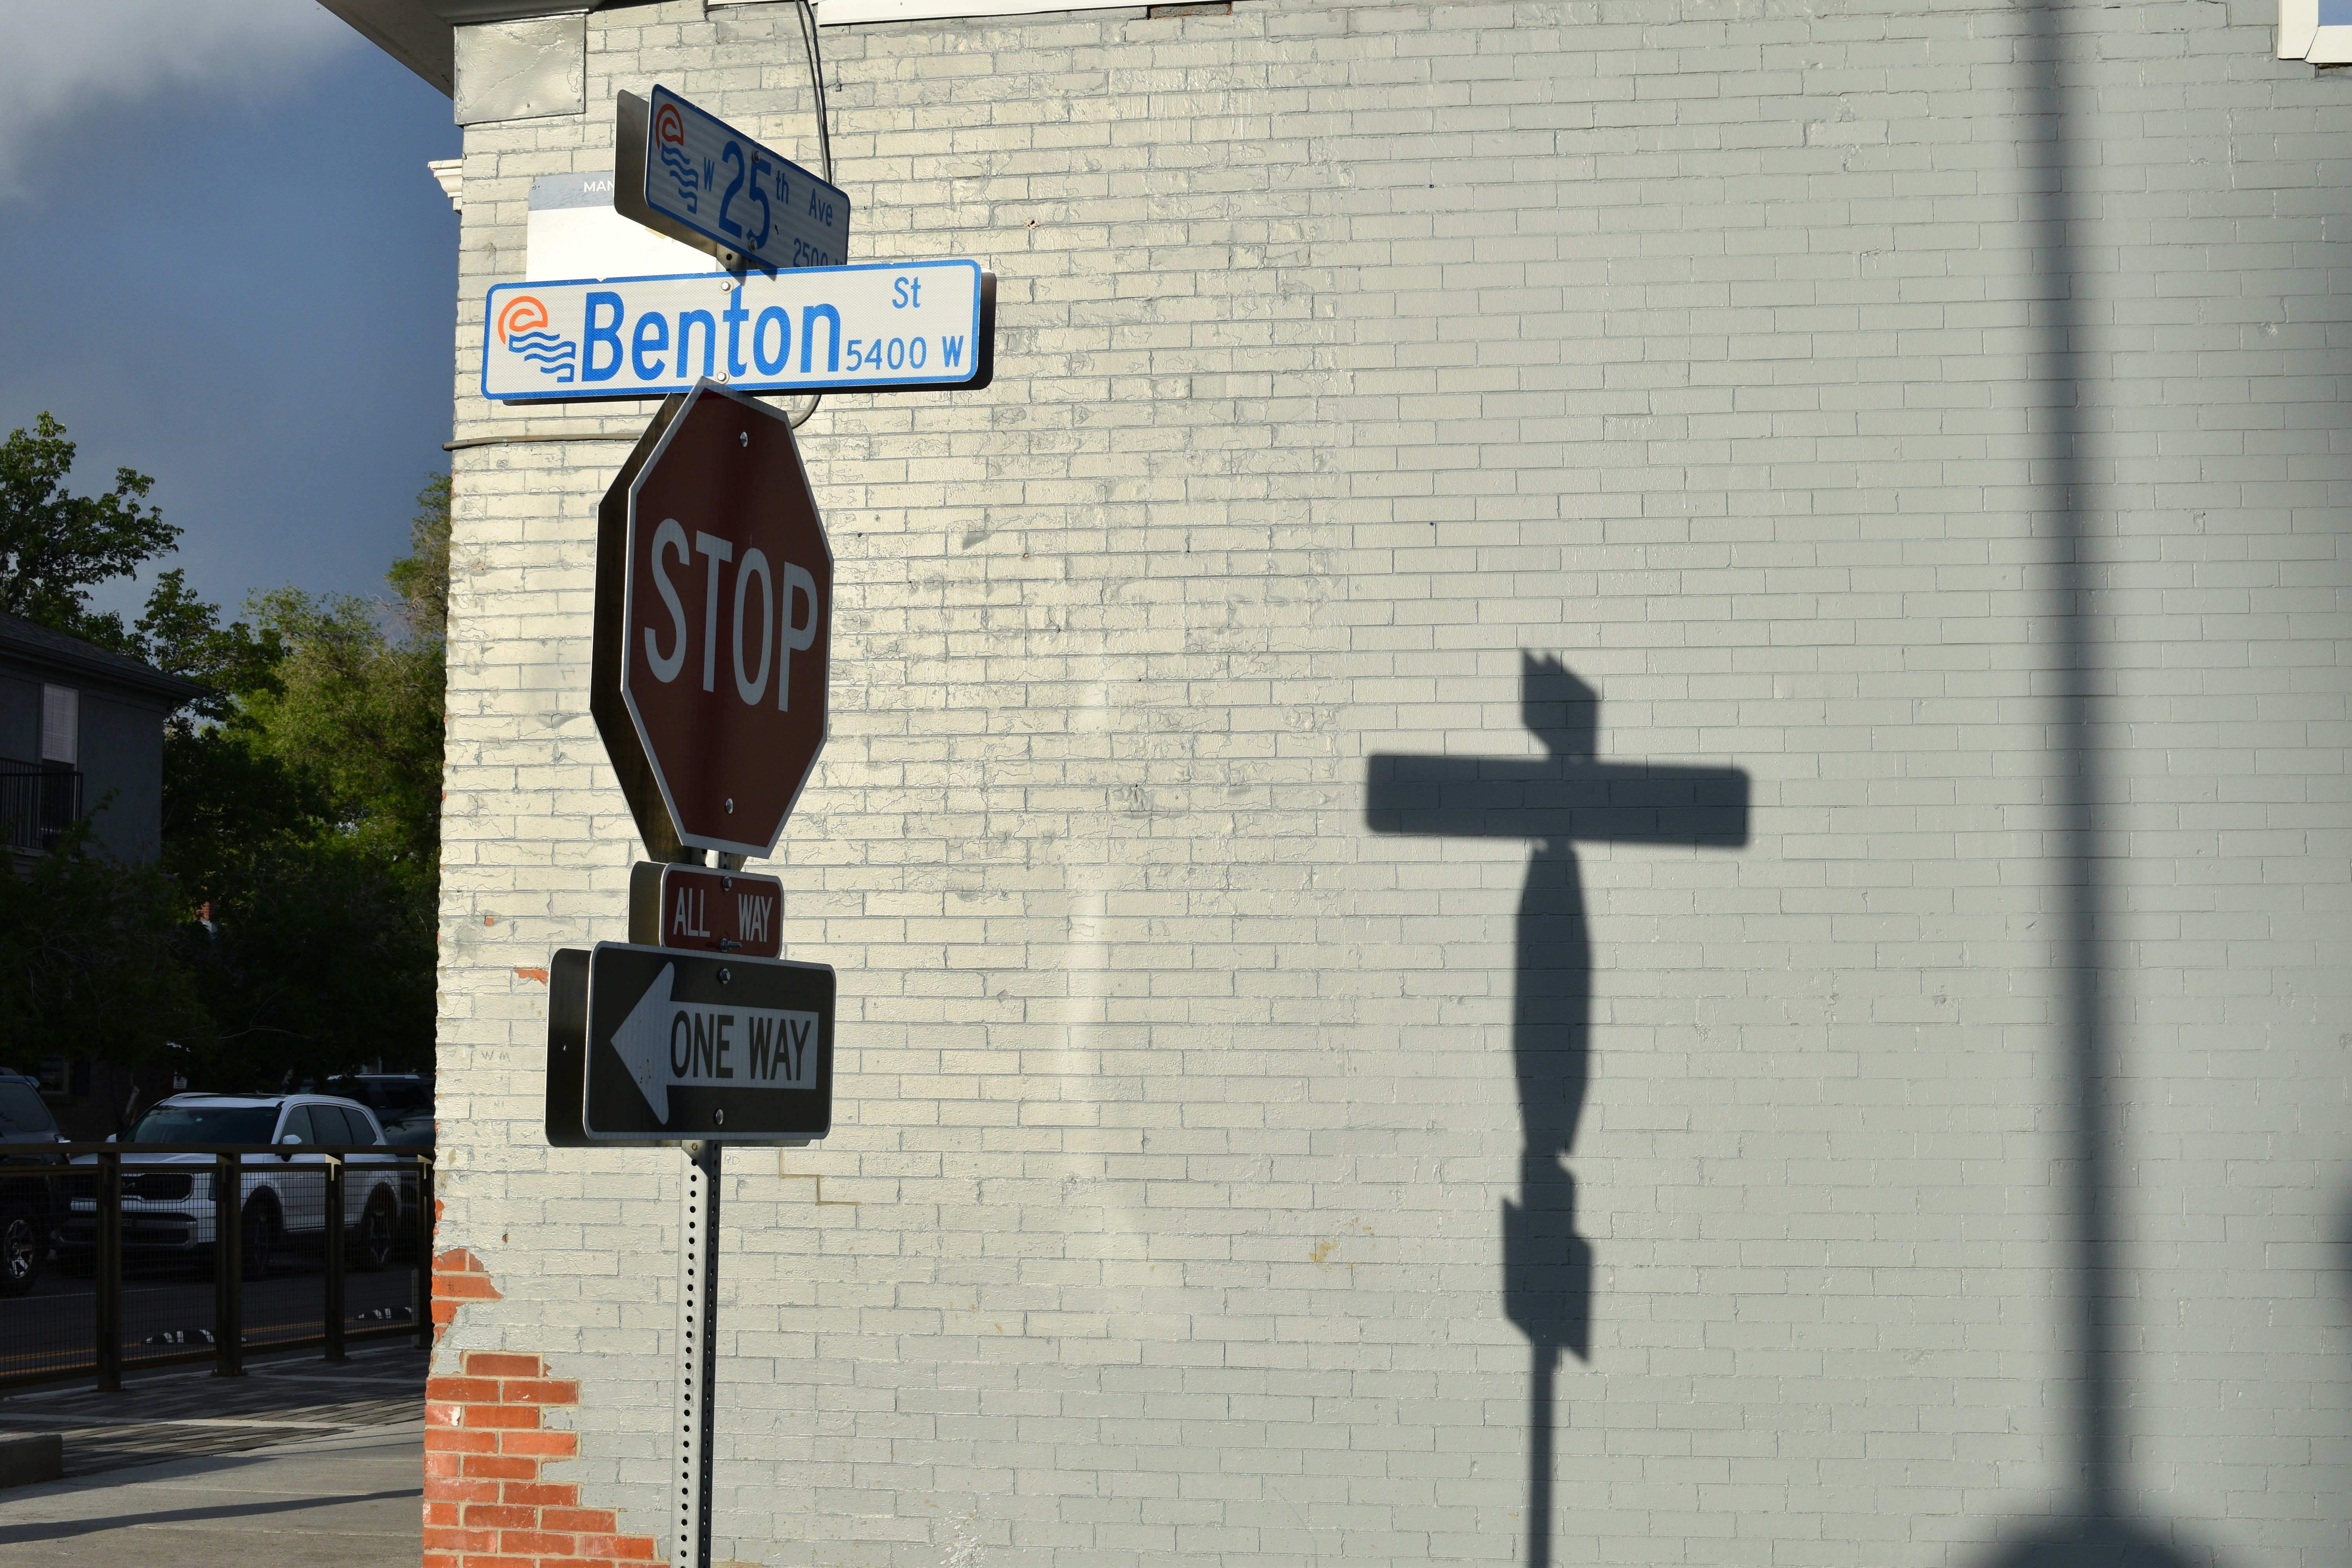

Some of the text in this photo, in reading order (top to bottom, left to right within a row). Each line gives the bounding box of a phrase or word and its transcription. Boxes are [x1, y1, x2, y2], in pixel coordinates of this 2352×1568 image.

[704, 156, 715, 192] W
[809, 188, 833, 227] Ave
[582, 276, 921, 382] Benton St
[846, 335, 964, 372] 5400 W
[644, 518, 818, 712] STOP
[673, 887, 773, 942] ALL WAY
[671, 1010, 811, 1081] ONE WAY
